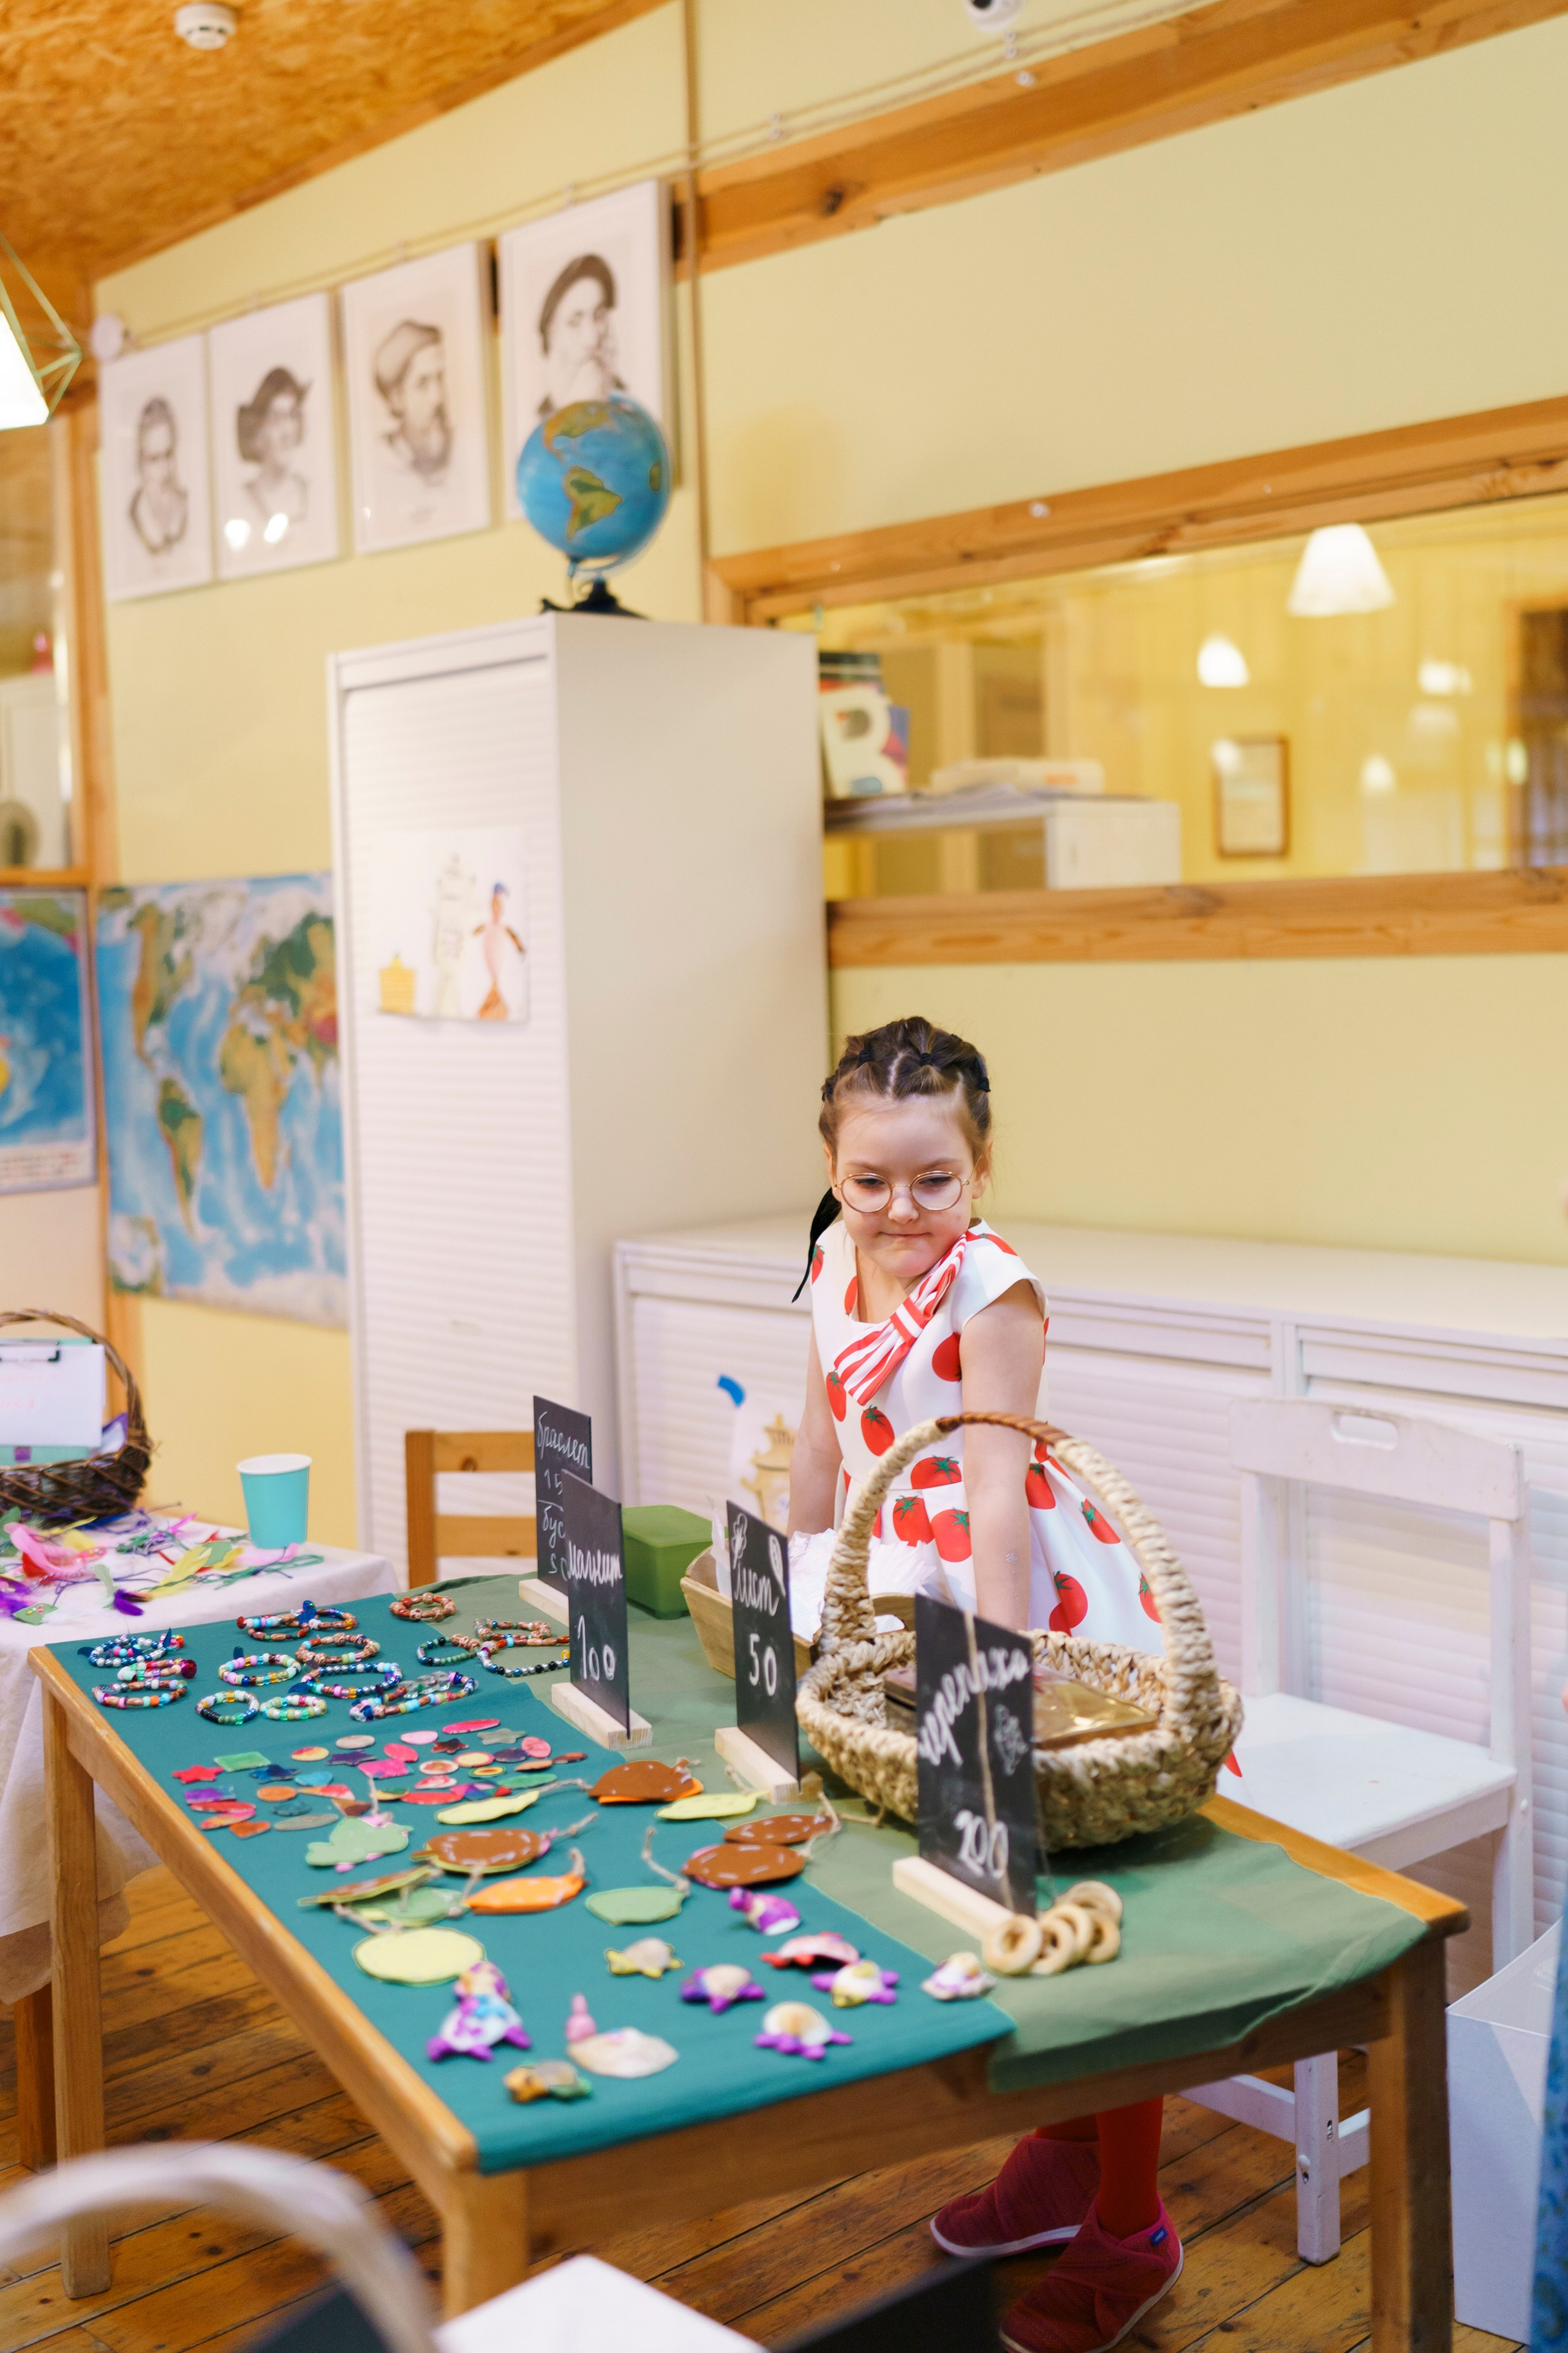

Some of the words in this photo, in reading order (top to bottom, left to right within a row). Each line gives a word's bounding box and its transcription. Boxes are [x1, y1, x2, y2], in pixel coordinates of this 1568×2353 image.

[542, 1505, 565, 1549] бус
[577, 1614, 615, 1681] 100
[749, 1633, 777, 1696] 50
[953, 1809, 1009, 1879] 200
